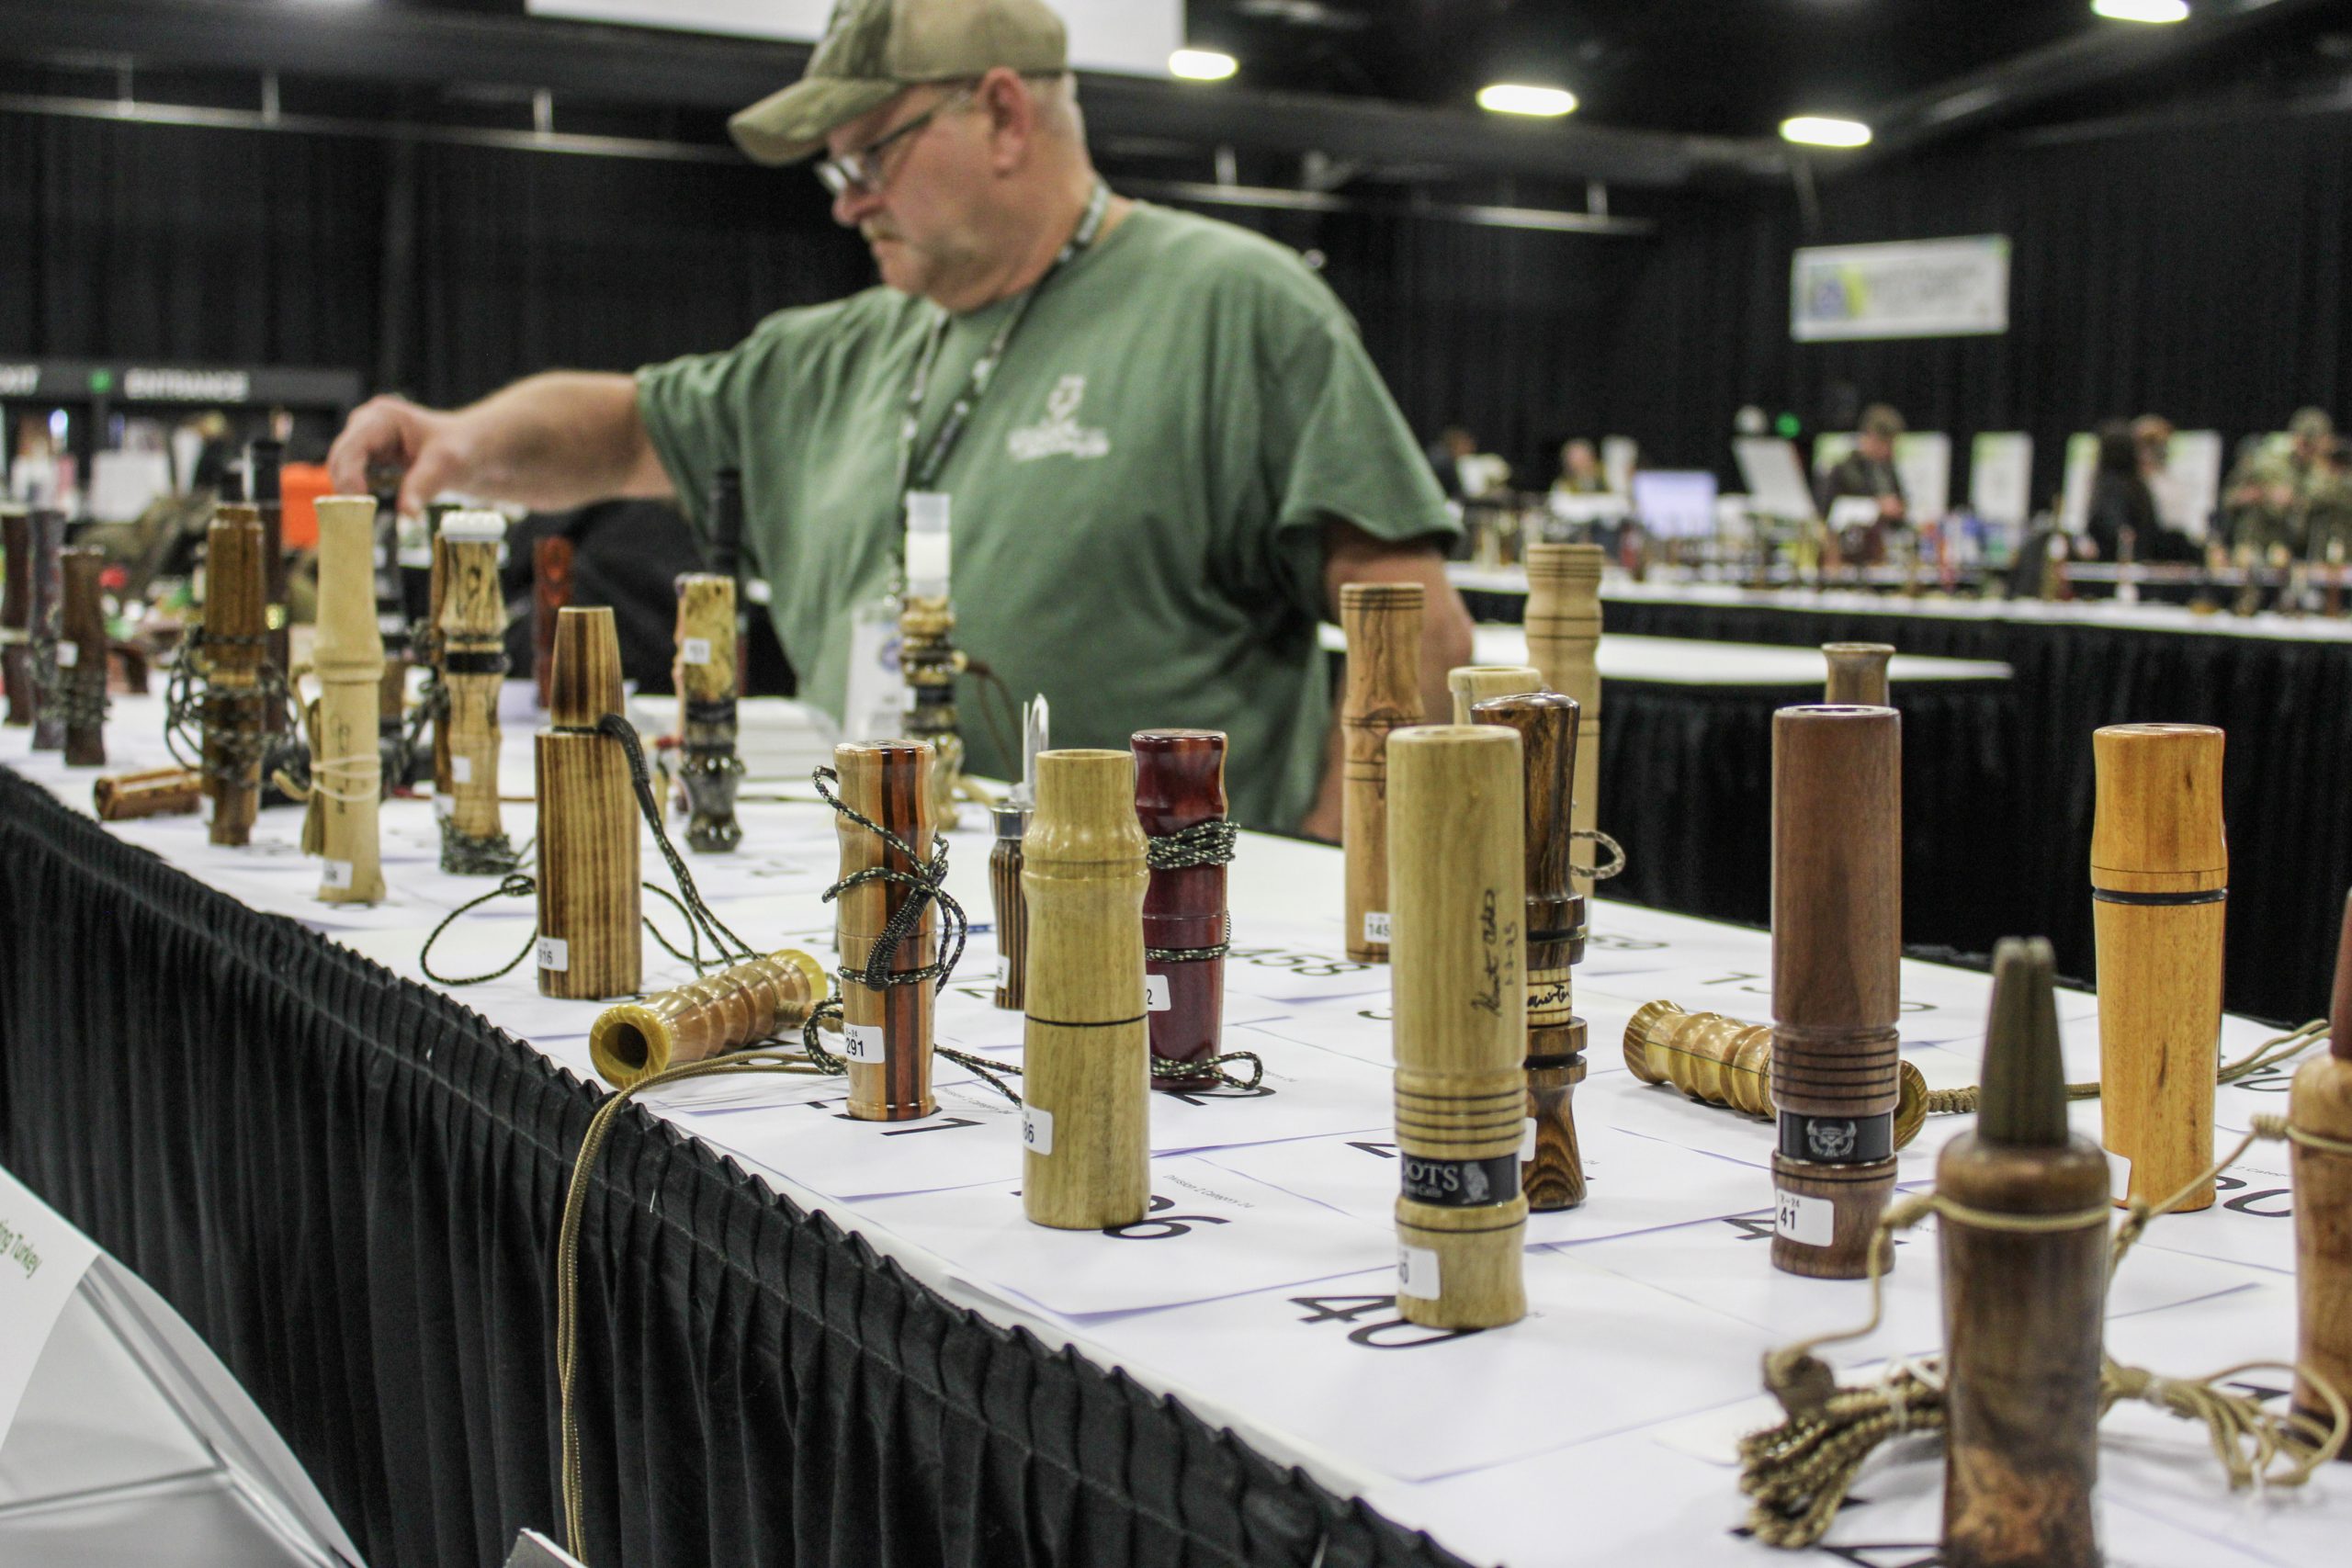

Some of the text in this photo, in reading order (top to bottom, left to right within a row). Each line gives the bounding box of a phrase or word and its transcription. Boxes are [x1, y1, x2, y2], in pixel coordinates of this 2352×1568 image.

[846, 1037, 864, 1056] 291
[1781, 1207, 1796, 1230] 41
[10, 1233, 43, 1280] Turkey
